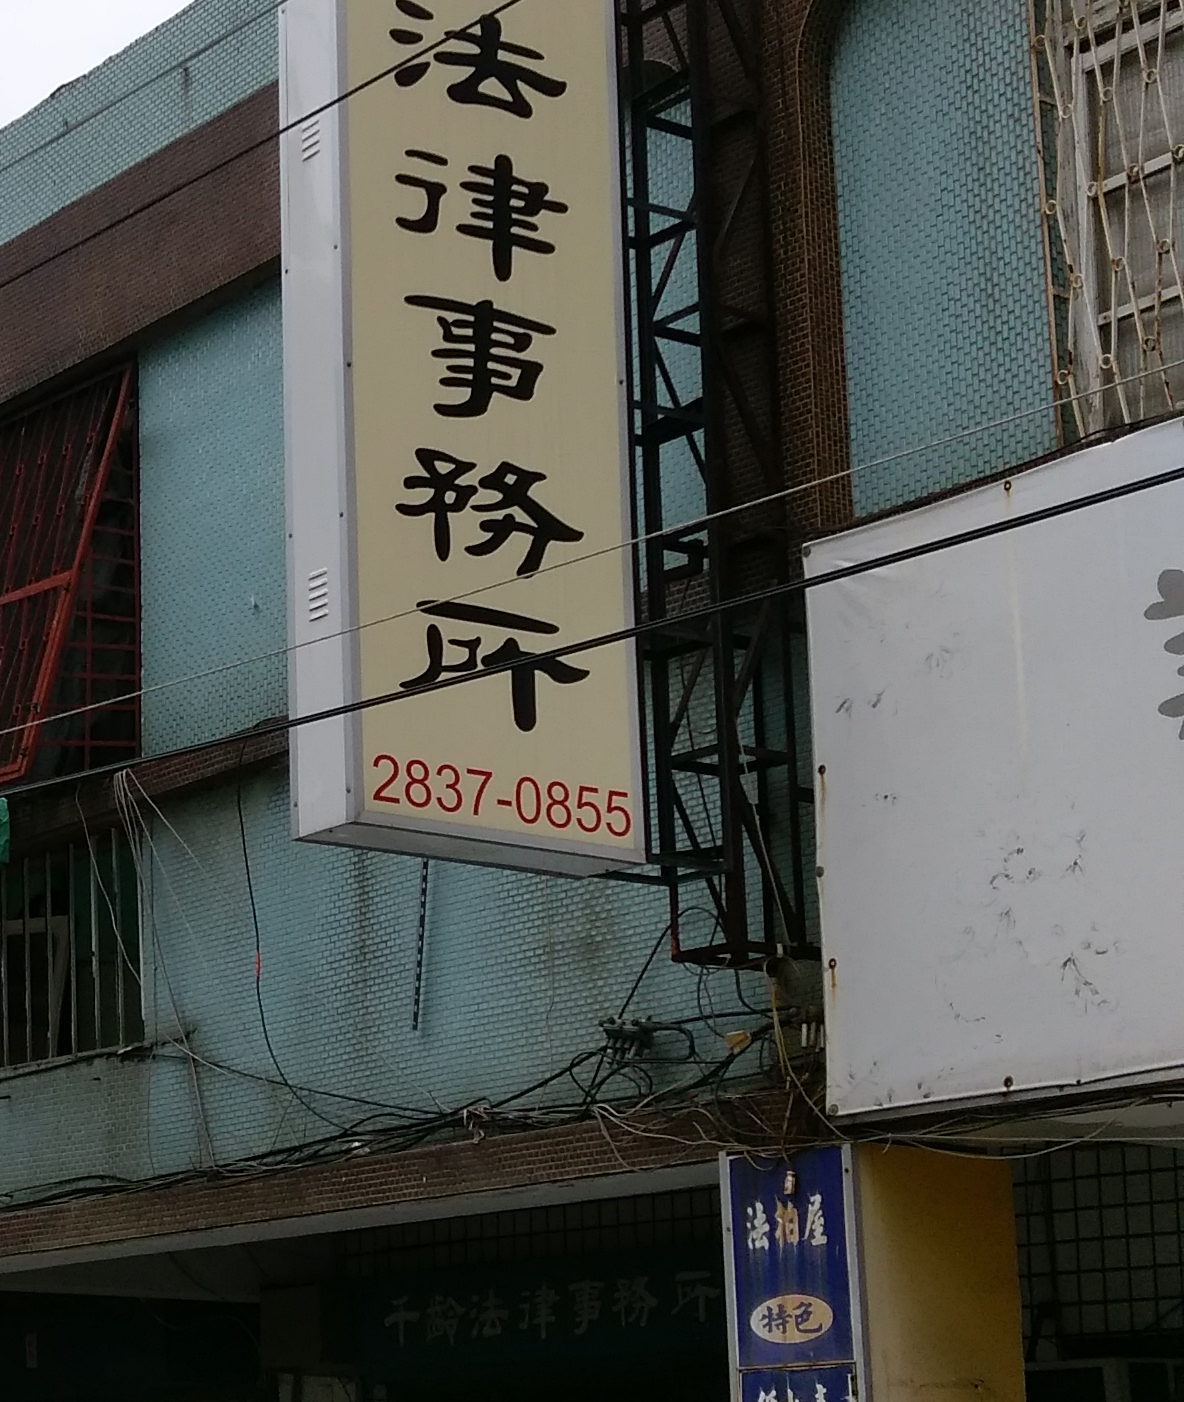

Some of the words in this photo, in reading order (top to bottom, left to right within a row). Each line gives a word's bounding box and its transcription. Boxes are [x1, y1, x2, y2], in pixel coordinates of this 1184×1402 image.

[371, 754, 632, 837] 2837-0855
[384, 1271, 721, 1348] 千齡法律事務所
[759, 1302, 823, 1335] 特色
